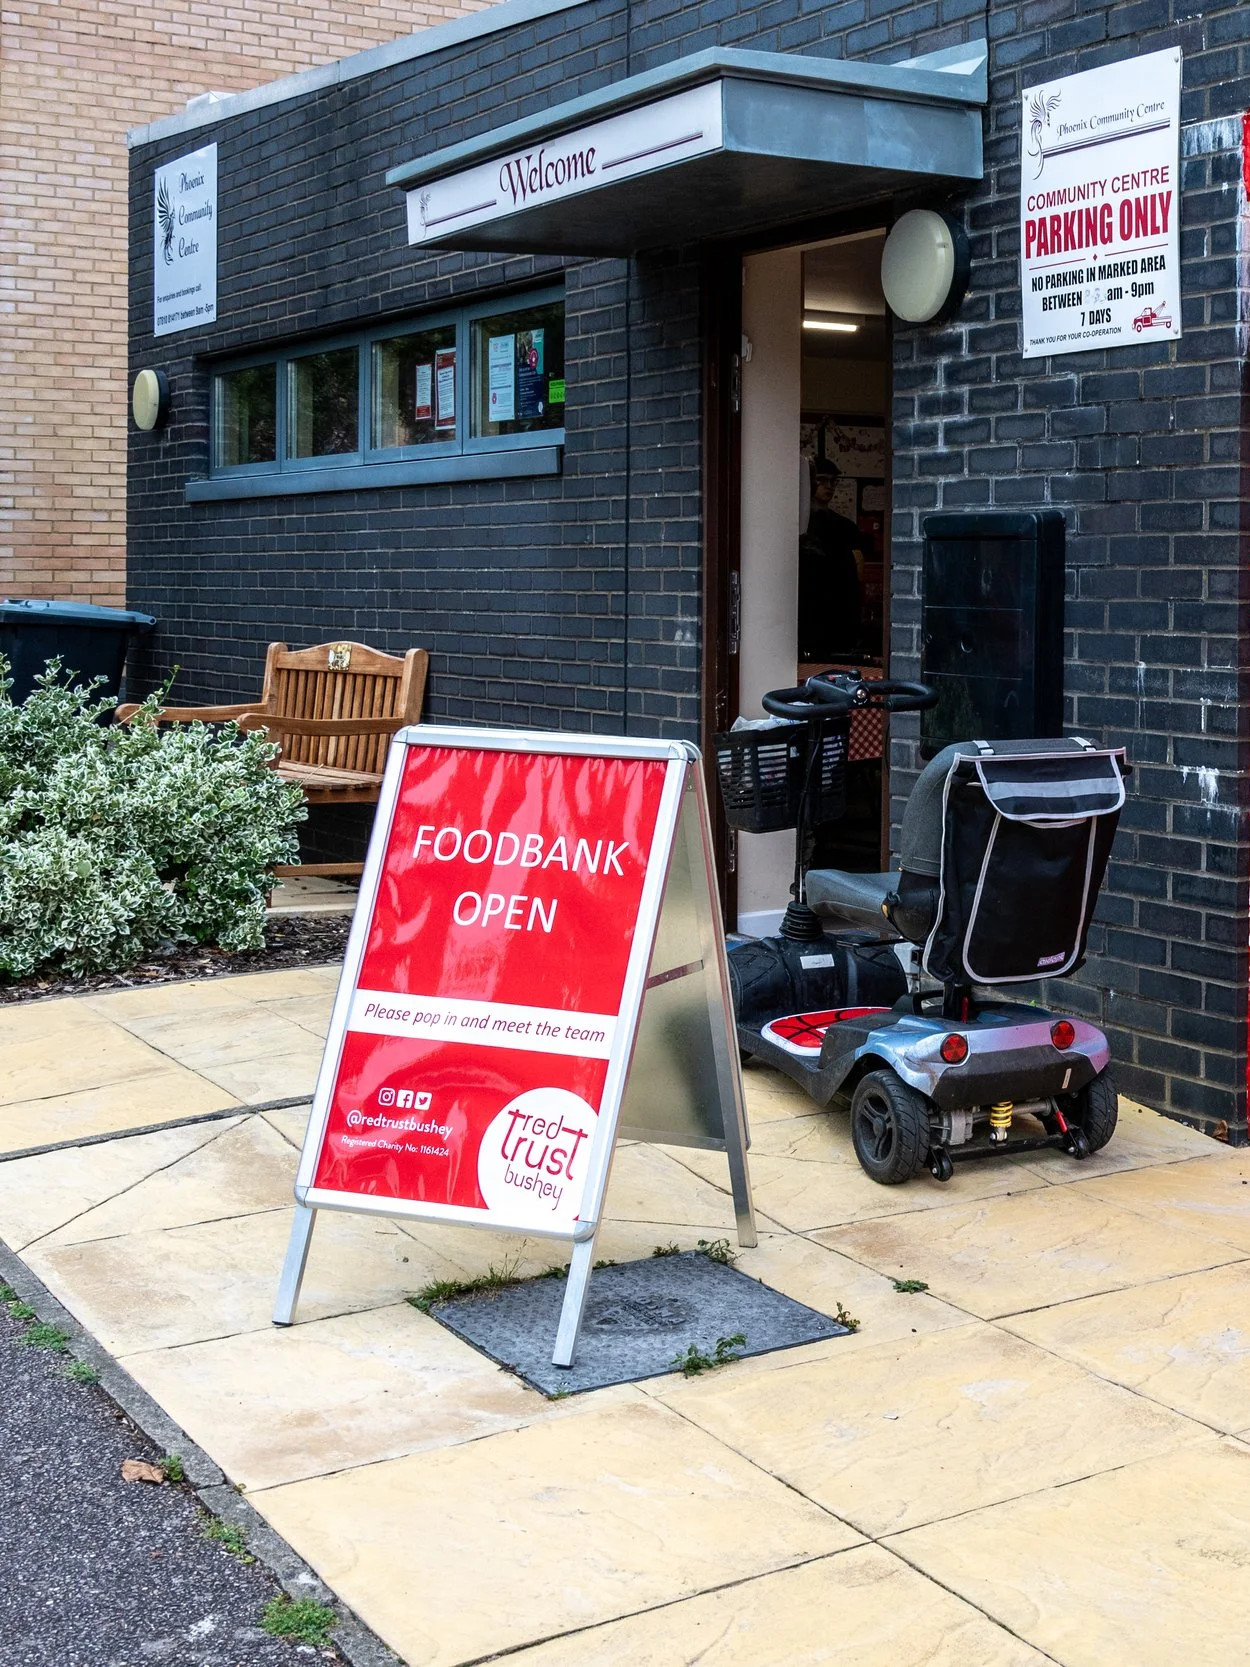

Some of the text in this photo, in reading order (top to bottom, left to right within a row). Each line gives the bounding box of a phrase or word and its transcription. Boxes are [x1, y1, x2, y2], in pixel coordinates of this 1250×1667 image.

[1056, 101, 1165, 141] Phoenix Community Centre
[179, 171, 205, 193] Phoenix
[499, 147, 597, 205] Welcome
[1027, 165, 1170, 212] COMMUNITY CENTRE
[178, 198, 213, 226] Community
[1025, 190, 1173, 260] PARKING ONLY
[178, 237, 200, 258] Centre
[1031, 254, 1166, 293] NO PARKING IN MARKED AREA
[1042, 290, 1083, 312] BETWEEN
[1131, 281, 1155, 298] 9pm
[1029, 326, 1122, 346] THANK YOU FOR YOUR CO-OPERATION
[1080, 307, 1112, 327] 7 DAYS
[412, 825, 629, 876] FOODBANK
[453, 891, 558, 933] OPEN
[364, 1003, 606, 1042] Please pop in and meet the team
[347, 1109, 454, 1141] @redtrustbushey
[522, 1115, 564, 1139] red
[341, 1135, 450, 1157] Registered Charity No: 1161424
[501, 1109, 588, 1181] trust
[504, 1163, 564, 1211] bushey
